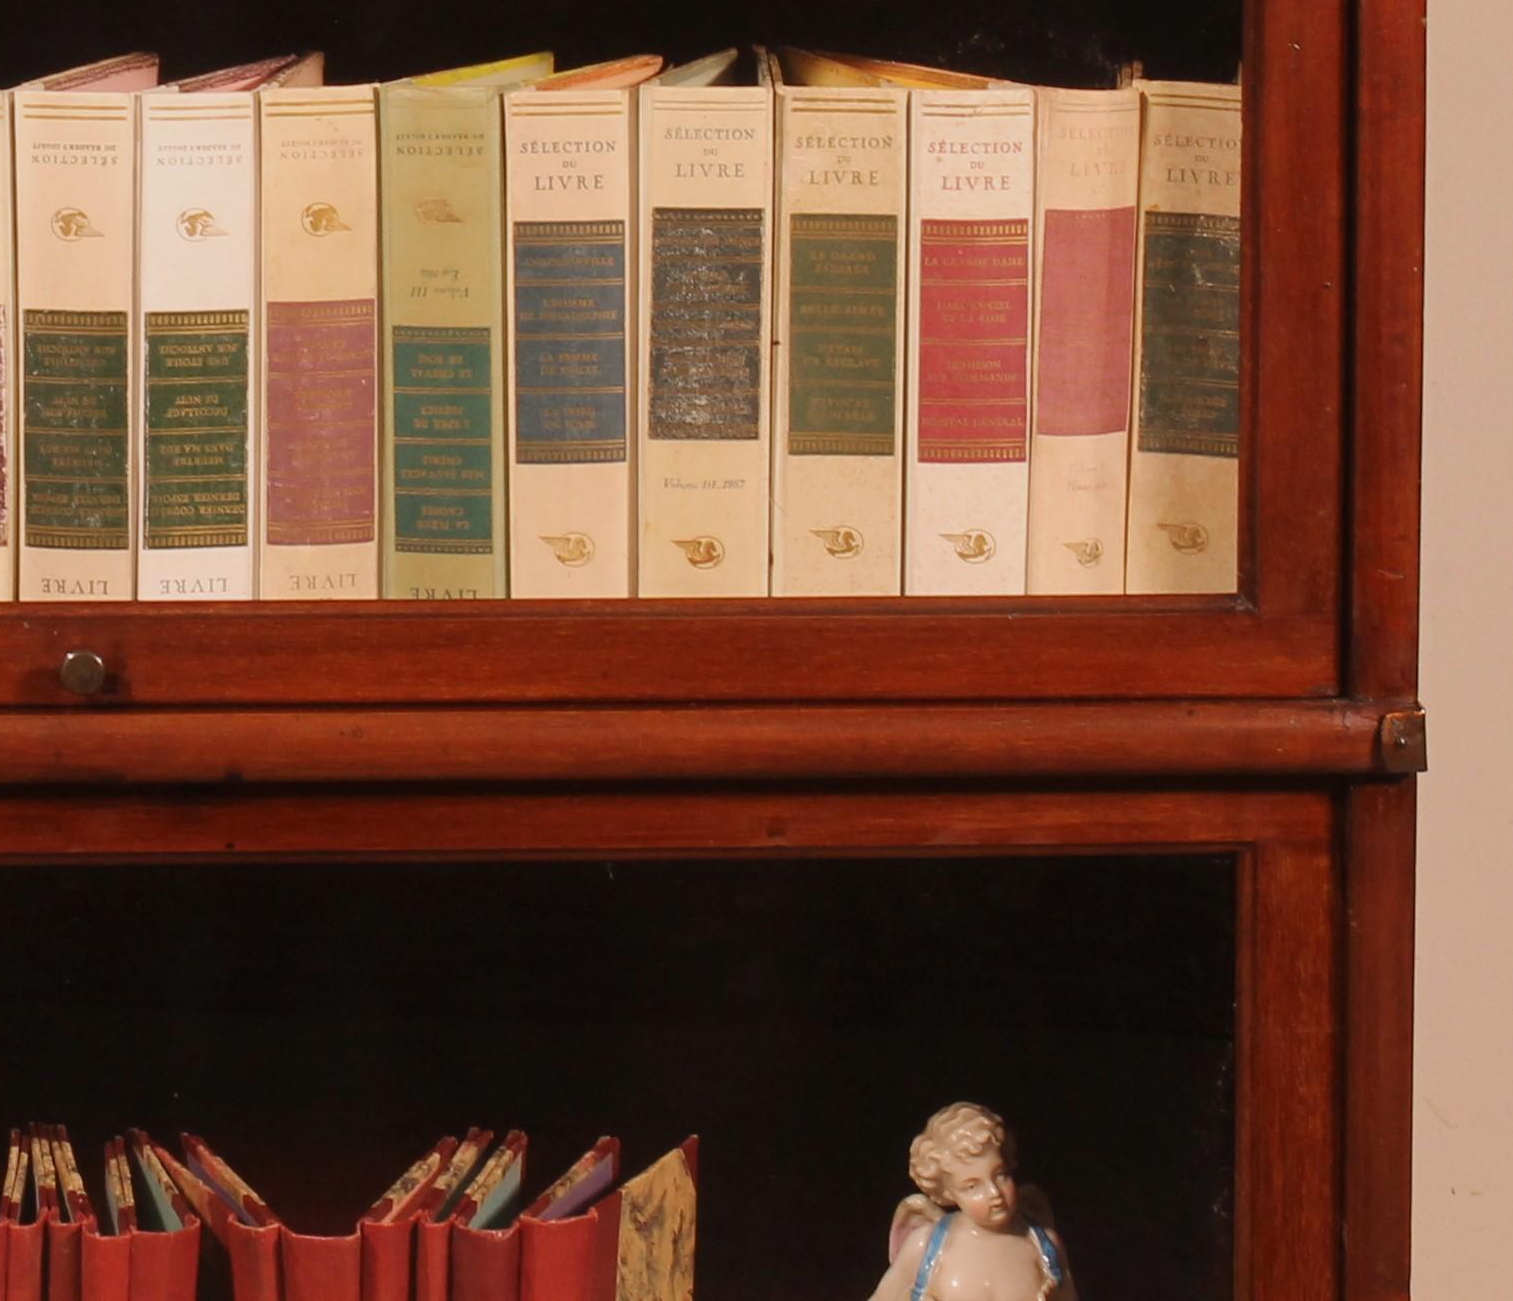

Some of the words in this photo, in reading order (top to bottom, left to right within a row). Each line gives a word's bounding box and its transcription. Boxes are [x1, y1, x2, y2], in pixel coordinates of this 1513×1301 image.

[664, 127, 756, 141] SÉLECTION
[795, 135, 893, 149] SÉLECTION
[1154, 133, 1237, 149] SÉLECTIO
[520, 140, 617, 155] SÉLECTION
[927, 139, 1023, 154] SÉLECTION
[675, 163, 745, 178] LIVRE
[970, 161, 984, 169] DU
[535, 174, 605, 191] LIVRE
[809, 170, 880, 186] LIVRE
[941, 175, 1011, 191] LIVRE
[1166, 168, 1236, 186] LIVRE
[924, 256, 939, 267] LA
[41, 578, 109, 595] LIVRE
[160, 578, 228, 595] LIVRE
[290, 574, 356, 590] LIVRE
